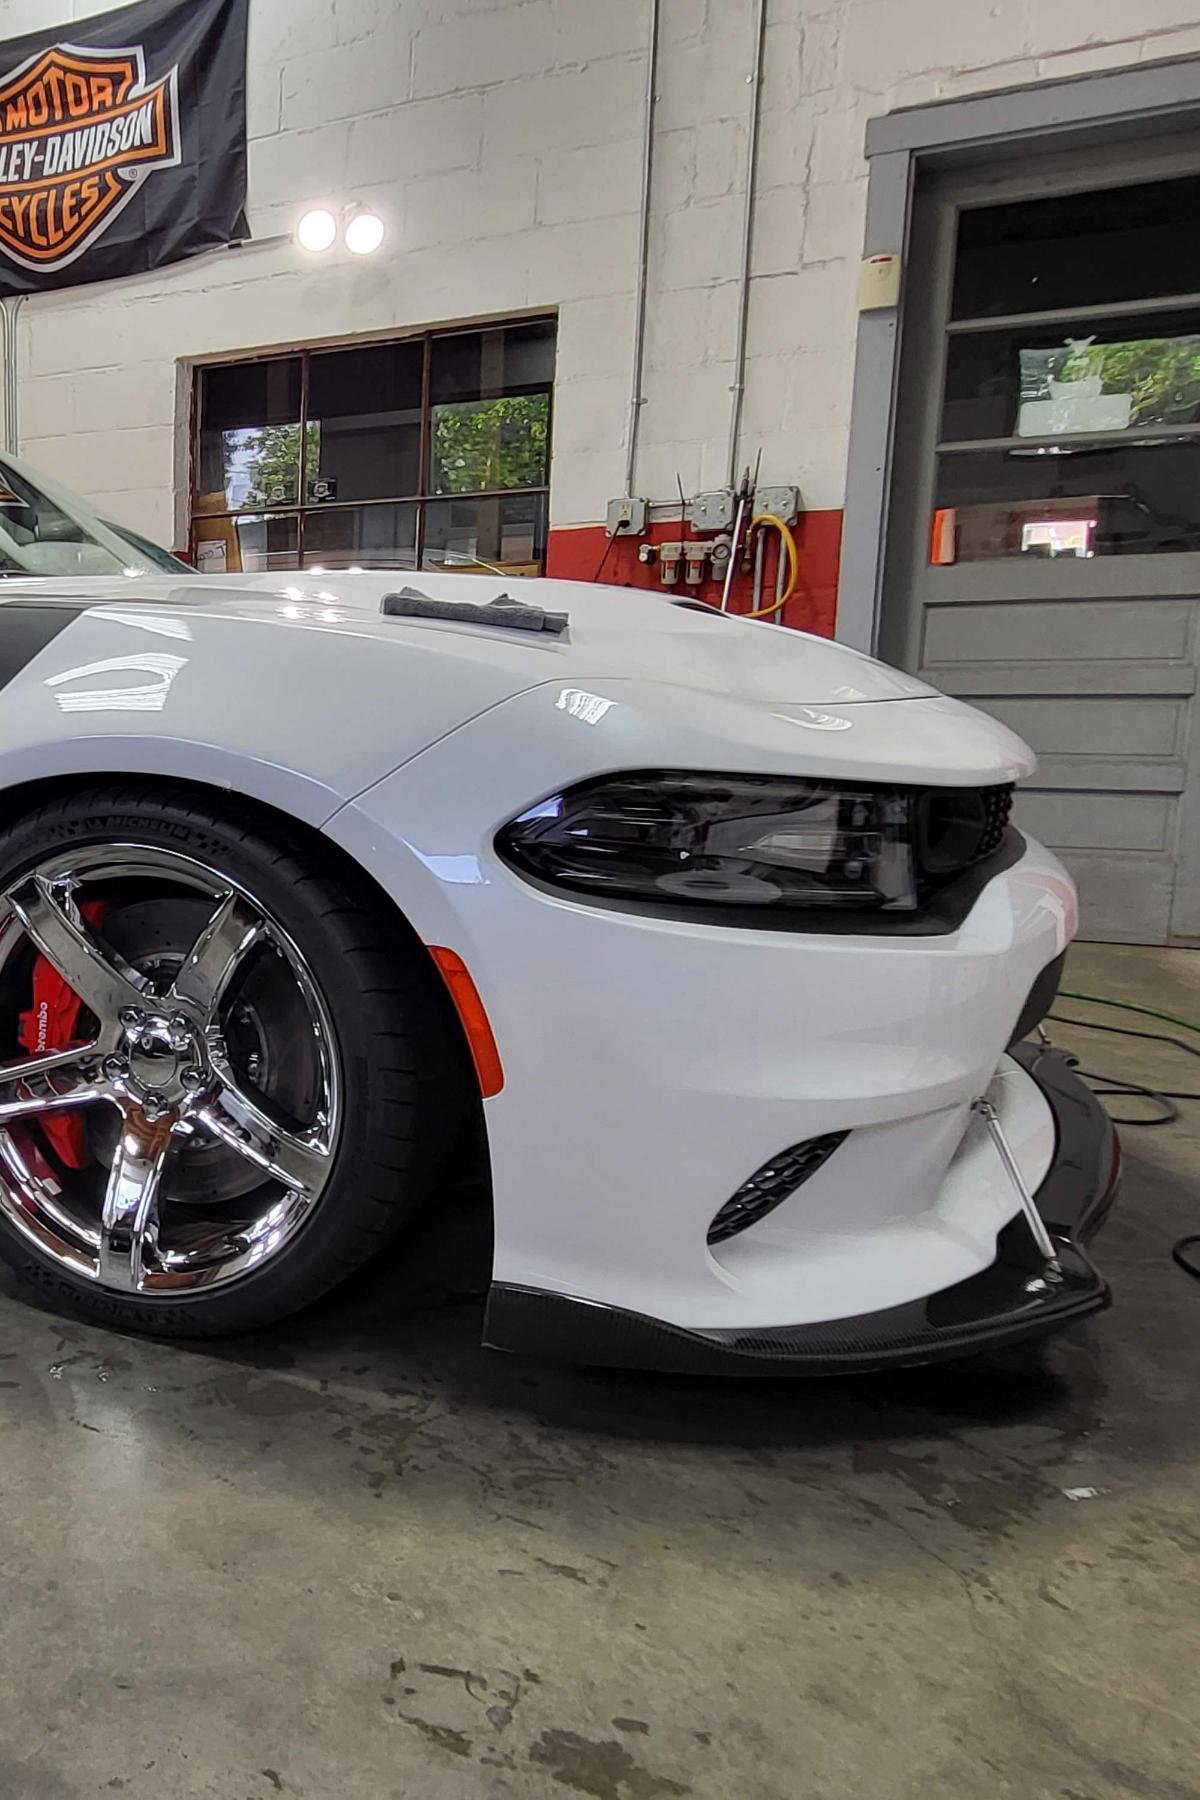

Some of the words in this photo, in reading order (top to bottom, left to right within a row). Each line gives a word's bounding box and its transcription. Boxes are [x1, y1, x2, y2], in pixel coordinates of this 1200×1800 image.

[5, 66, 113, 131] MOTOR
[106, 815, 189, 840] MICHELIN
[34, 1001, 49, 1053] brembo
